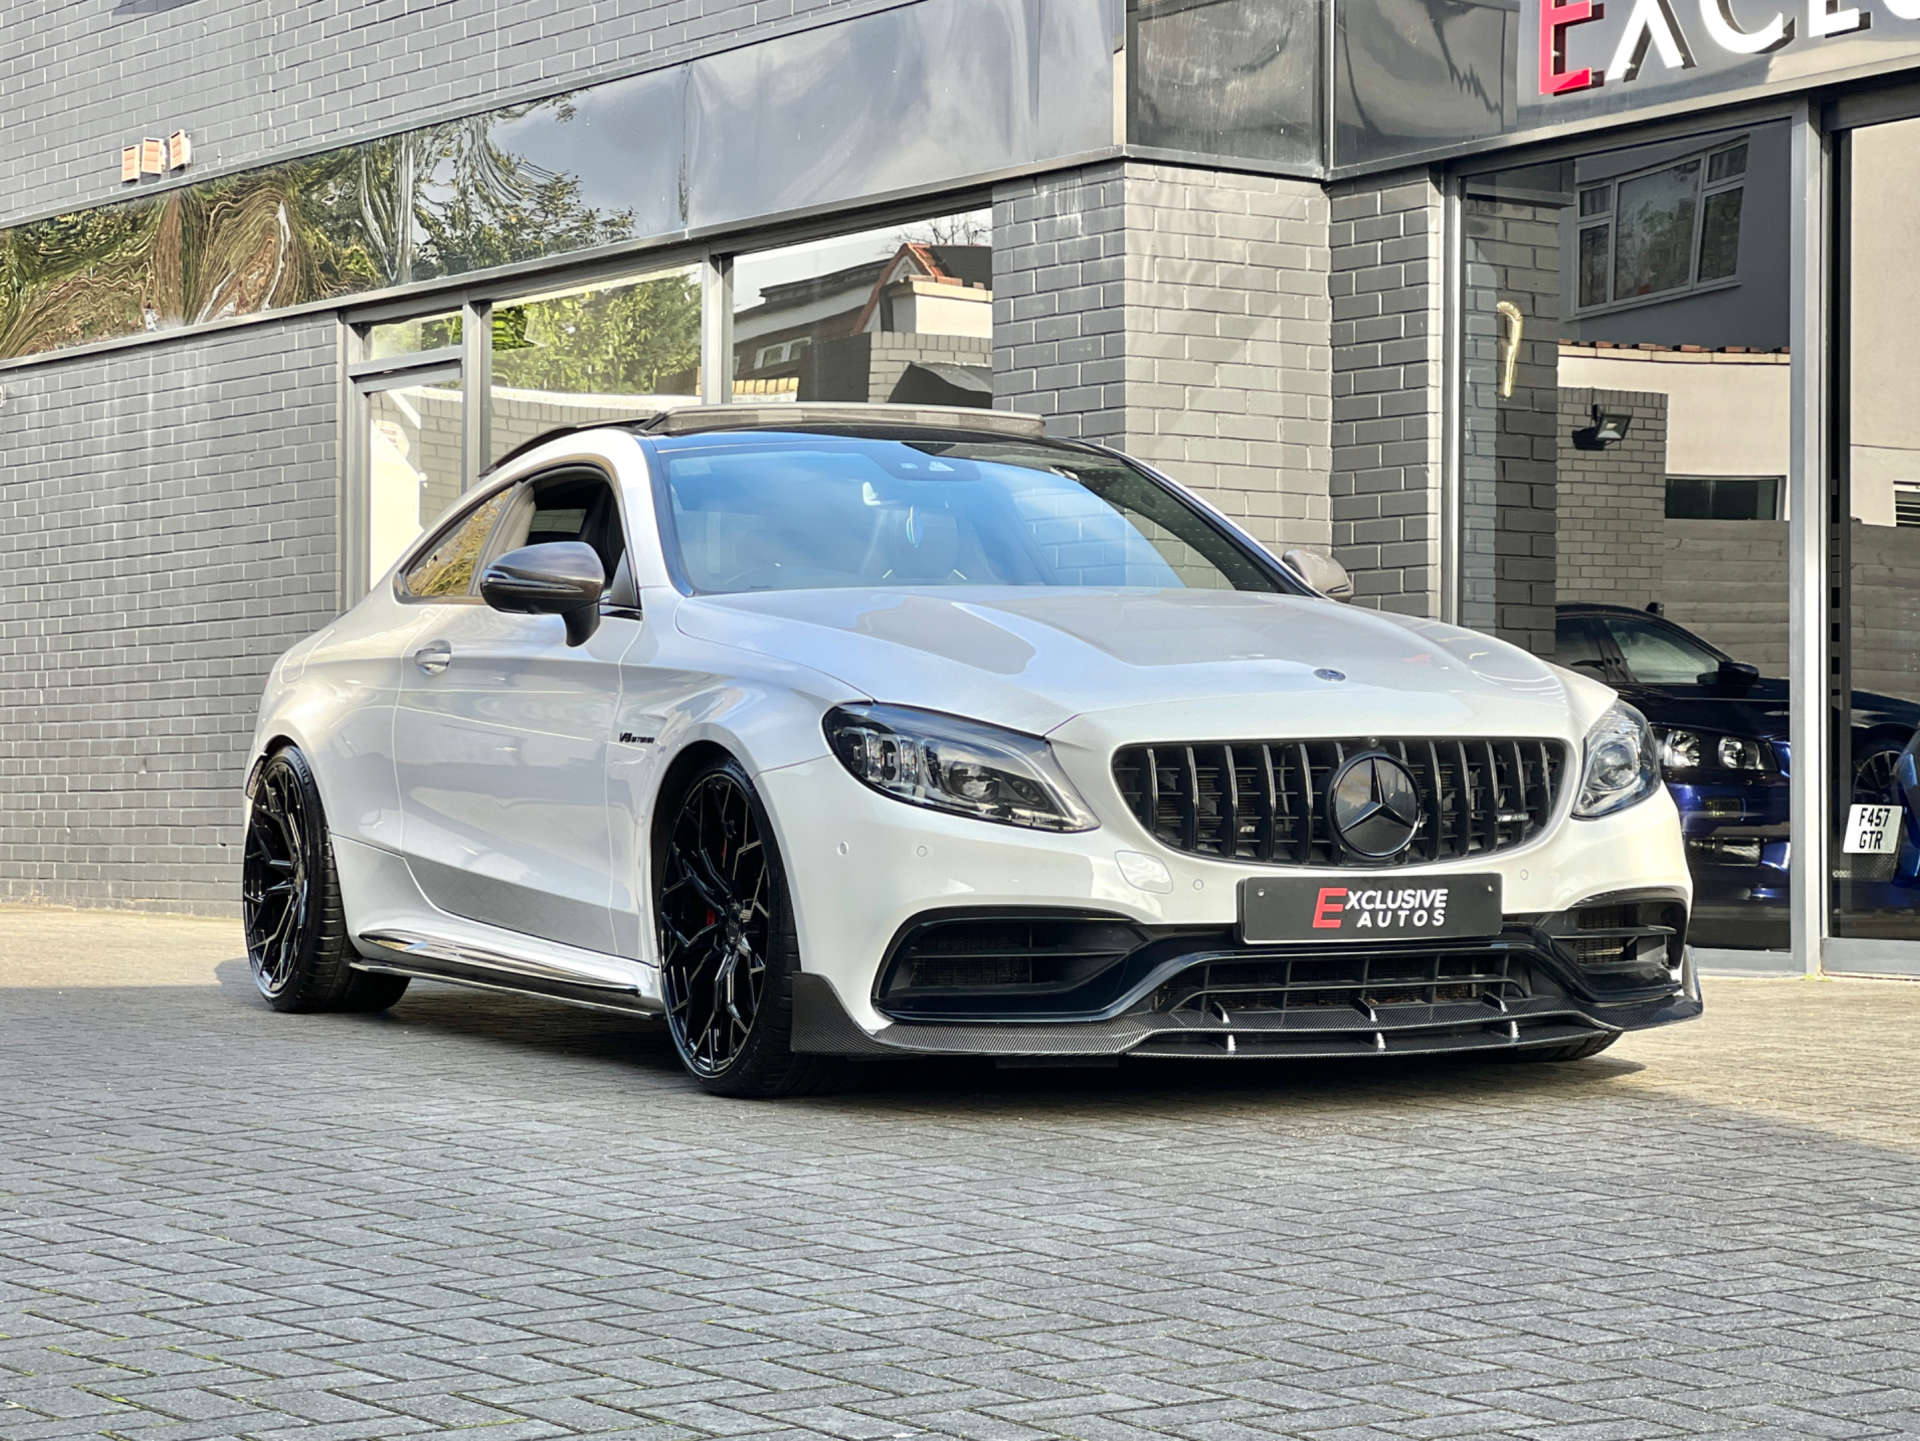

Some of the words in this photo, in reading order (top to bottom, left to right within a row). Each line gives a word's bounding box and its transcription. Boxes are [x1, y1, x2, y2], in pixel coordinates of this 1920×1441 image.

[1859, 807, 1891, 828] F457
[1858, 830, 1883, 850] GTR
[1312, 887, 1449, 929] EXCLUSIVE
[1356, 909, 1445, 928] AUTOS
